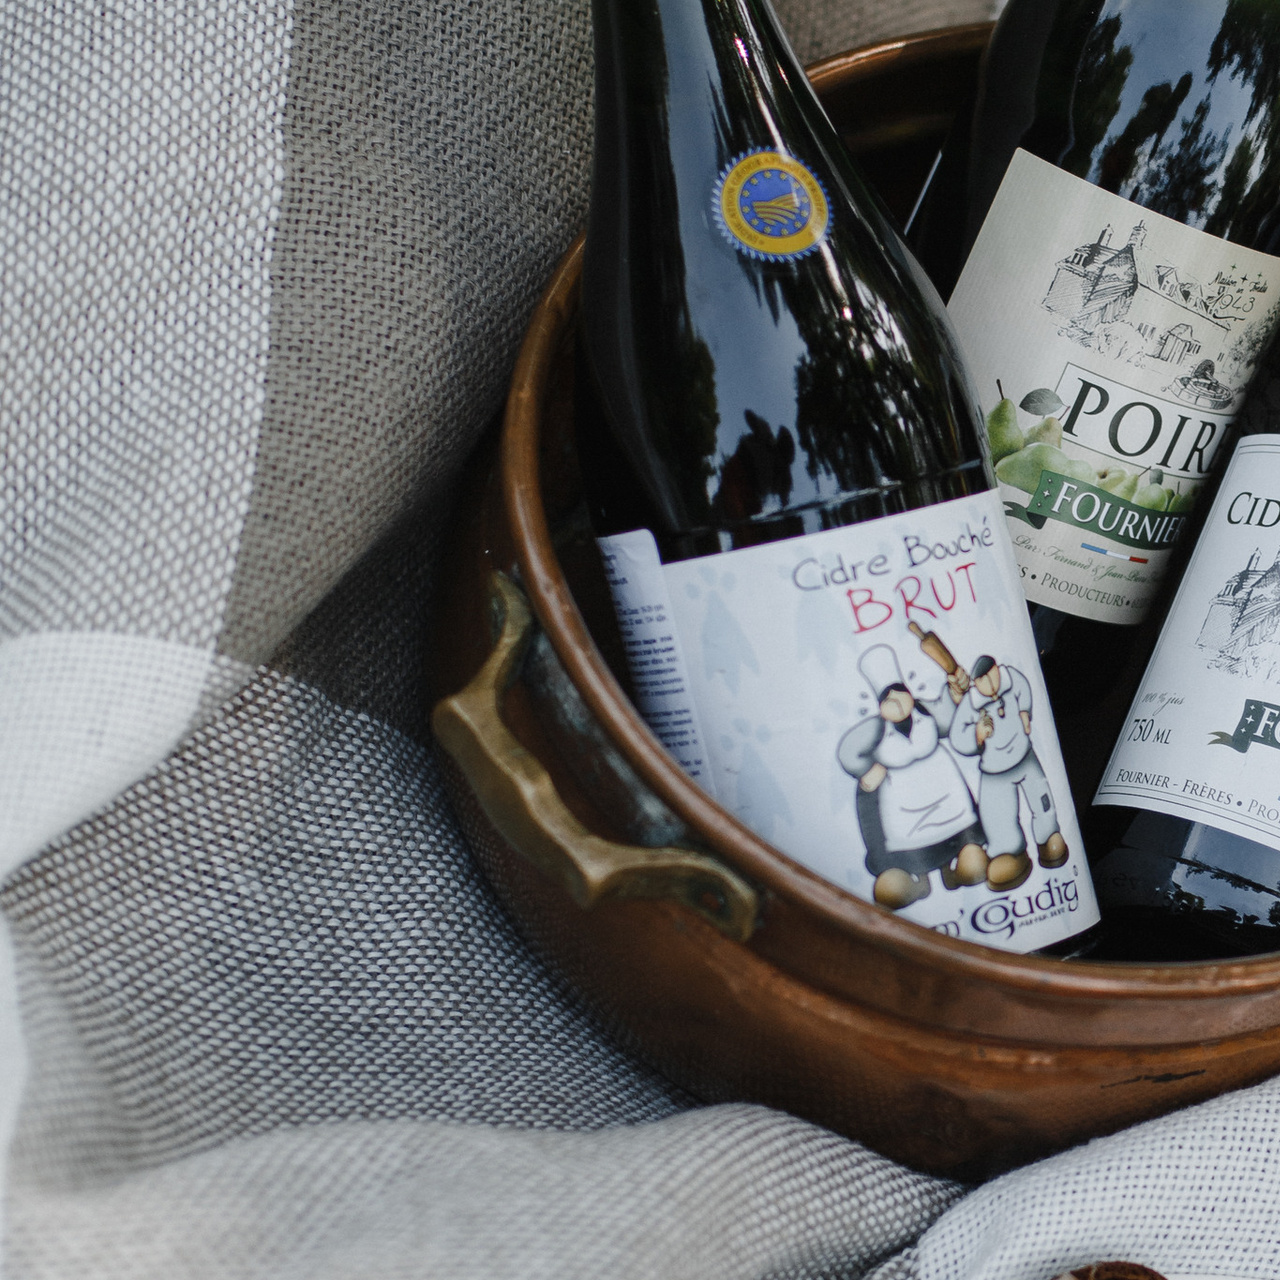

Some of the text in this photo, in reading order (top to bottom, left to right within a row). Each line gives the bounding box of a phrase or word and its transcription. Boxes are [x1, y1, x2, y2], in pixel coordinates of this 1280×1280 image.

[1208, 293, 1256, 313] 1943
[792, 516, 994, 592] Cidre Bouché
[846, 561, 978, 634] BRUT
[1041, 572, 1127, 608] PRODUCTEURS
[1126, 718, 1172, 745] 750 ML
[1115, 768, 1171, 790] FOURNIER
[1181, 779, 1234, 806] FRÈRES
